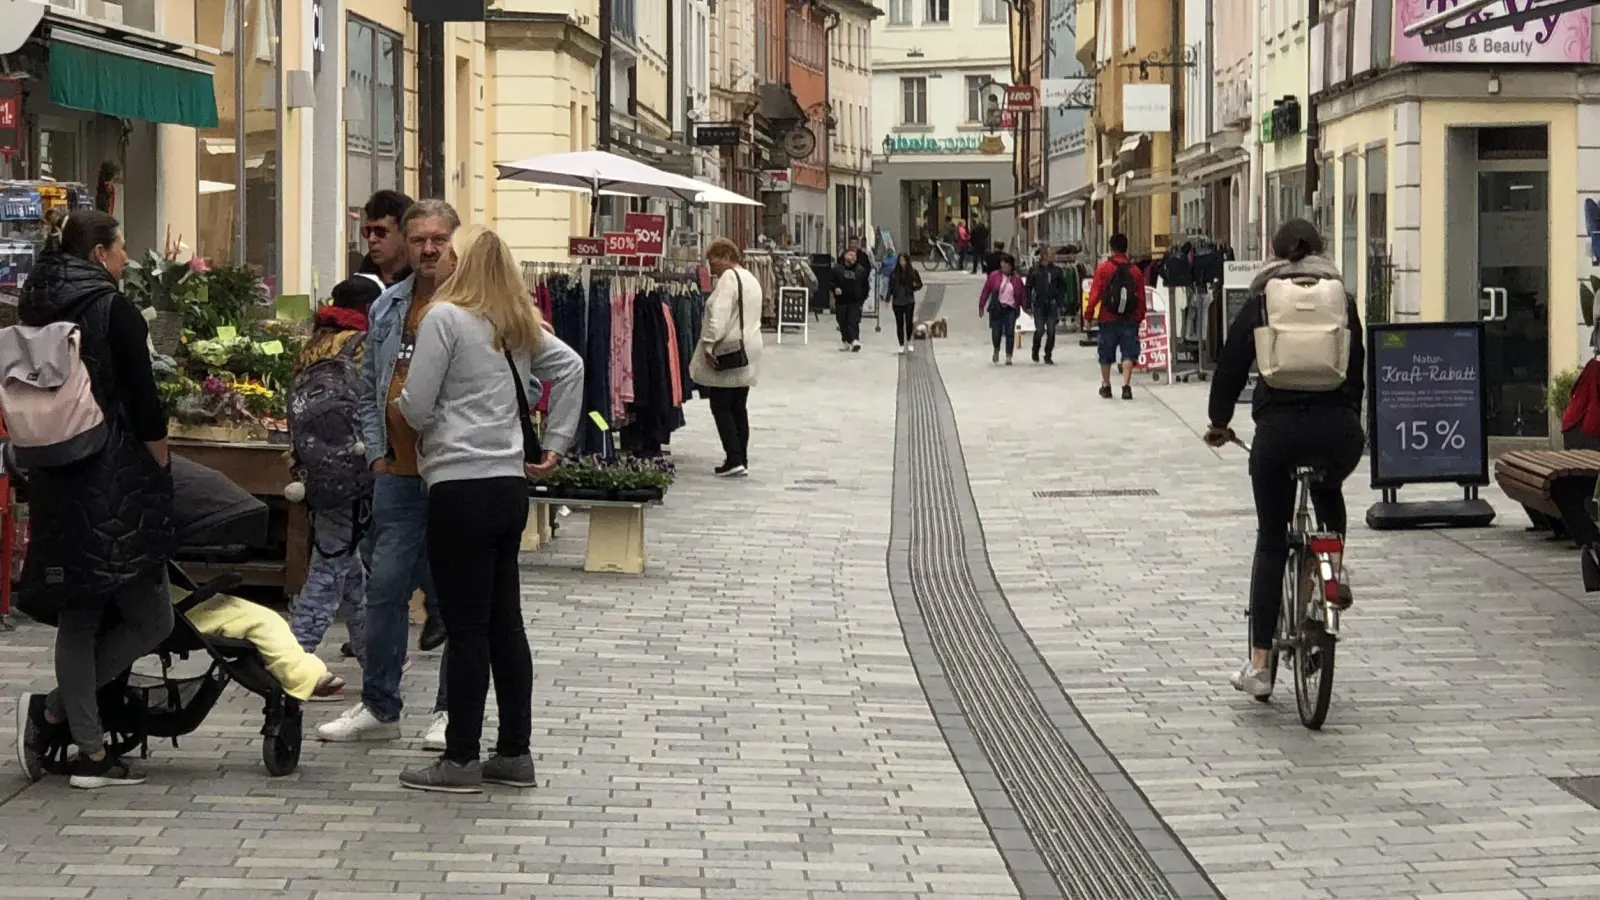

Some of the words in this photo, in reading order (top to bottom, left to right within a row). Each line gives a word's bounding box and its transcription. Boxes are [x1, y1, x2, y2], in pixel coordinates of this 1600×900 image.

[1428, 40, 1463, 54] Nails
[1468, 38, 1478, 53] &
[1483, 38, 1533, 56] Beauty
[1009, 91, 1031, 101] LEGO
[572, 244, 599, 254] -50%
[1412, 354, 1443, 364] Natur-
[1381, 365, 1476, 384] Kraft-Rabatt
[1395, 420, 1429, 451] 15
[1435, 420, 1466, 451] %
